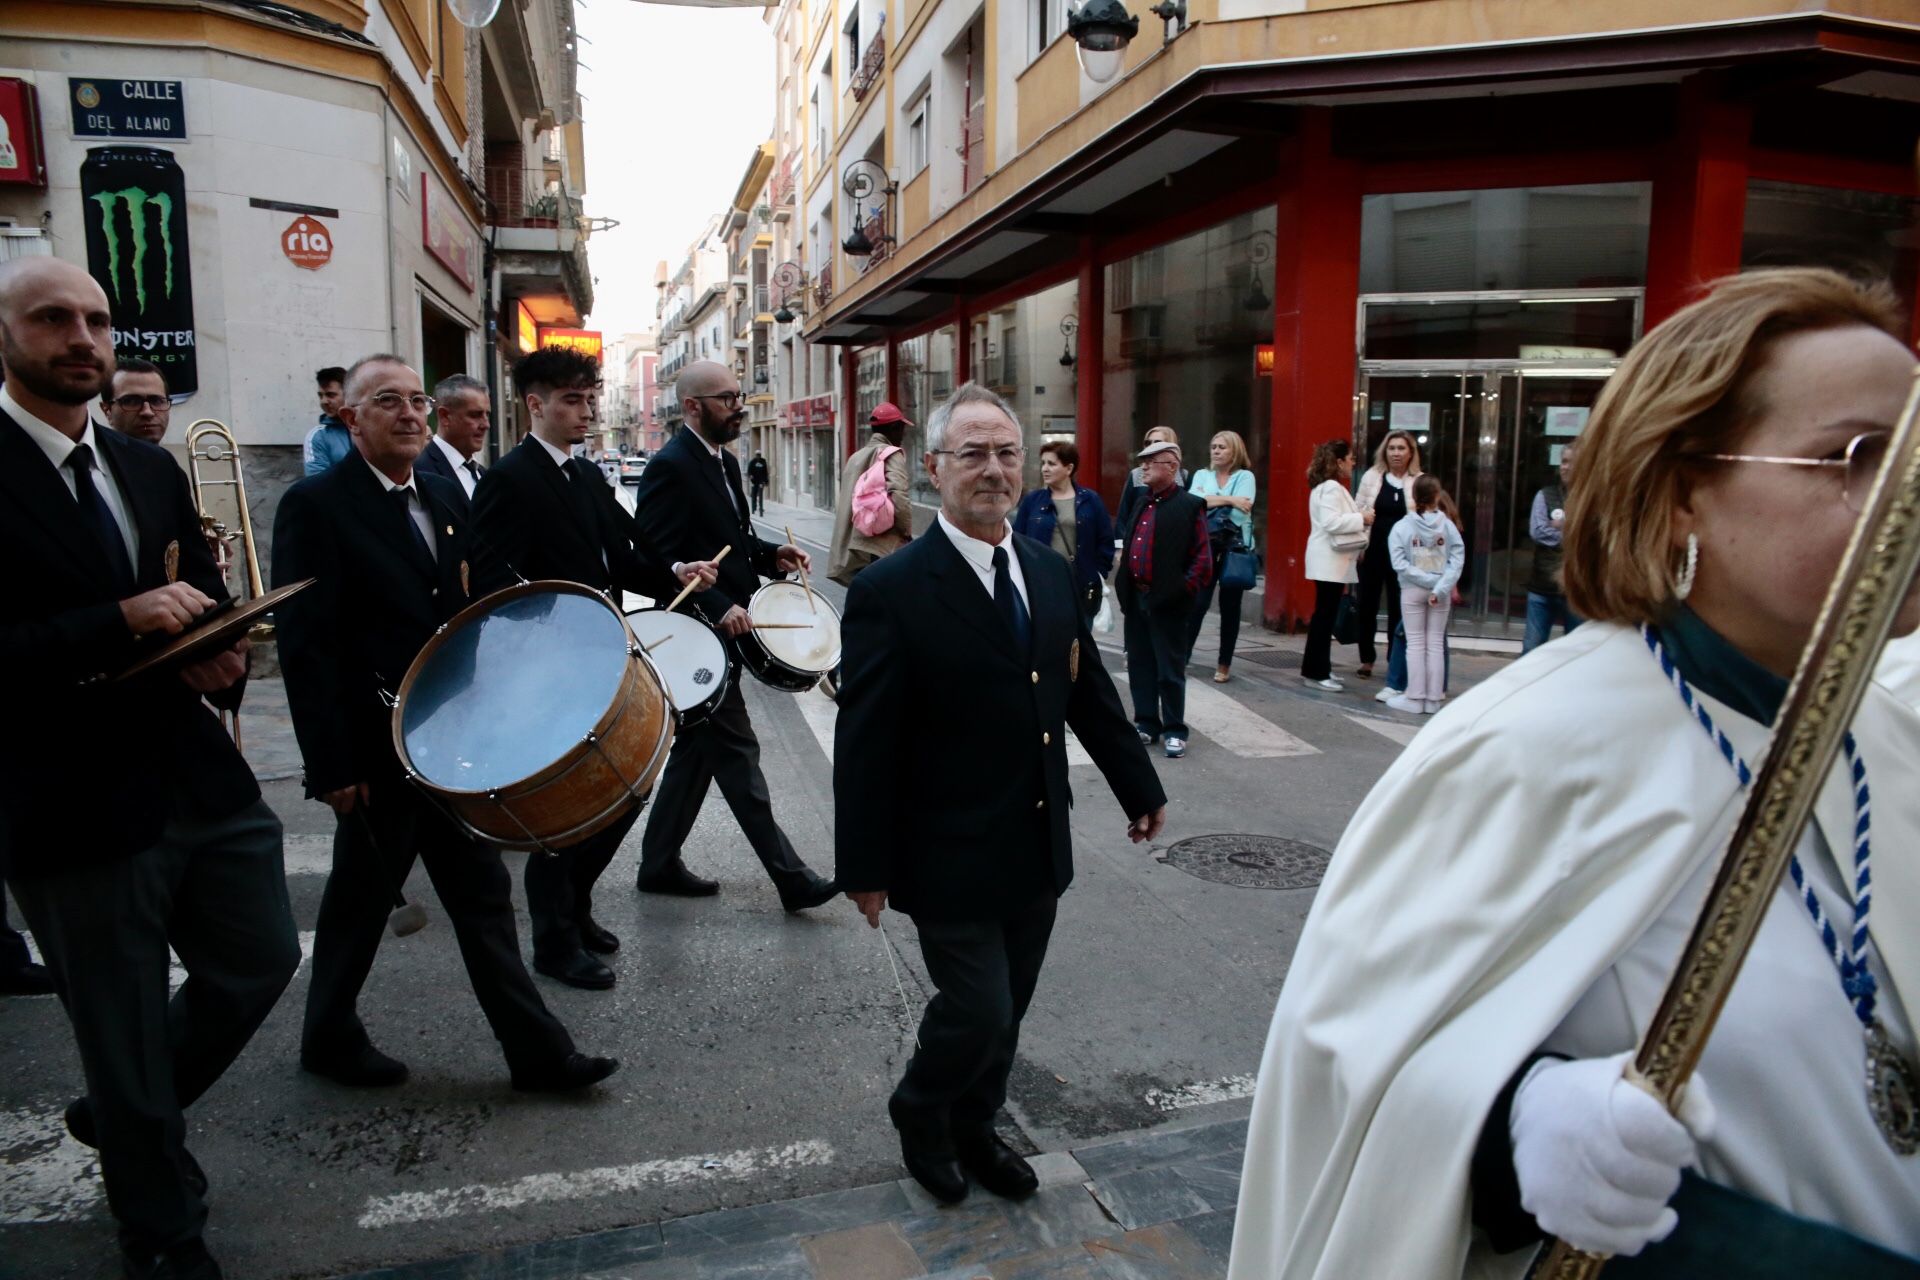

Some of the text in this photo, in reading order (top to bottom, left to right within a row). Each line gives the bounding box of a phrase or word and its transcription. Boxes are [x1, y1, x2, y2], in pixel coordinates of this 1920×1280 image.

[122, 81, 176, 100] CALLE
[88, 114, 171, 131] DEL ALAMO
[288, 223, 328, 252] ria
[110, 326, 195, 350] ONSTER
[117, 354, 187, 362] NERGY
